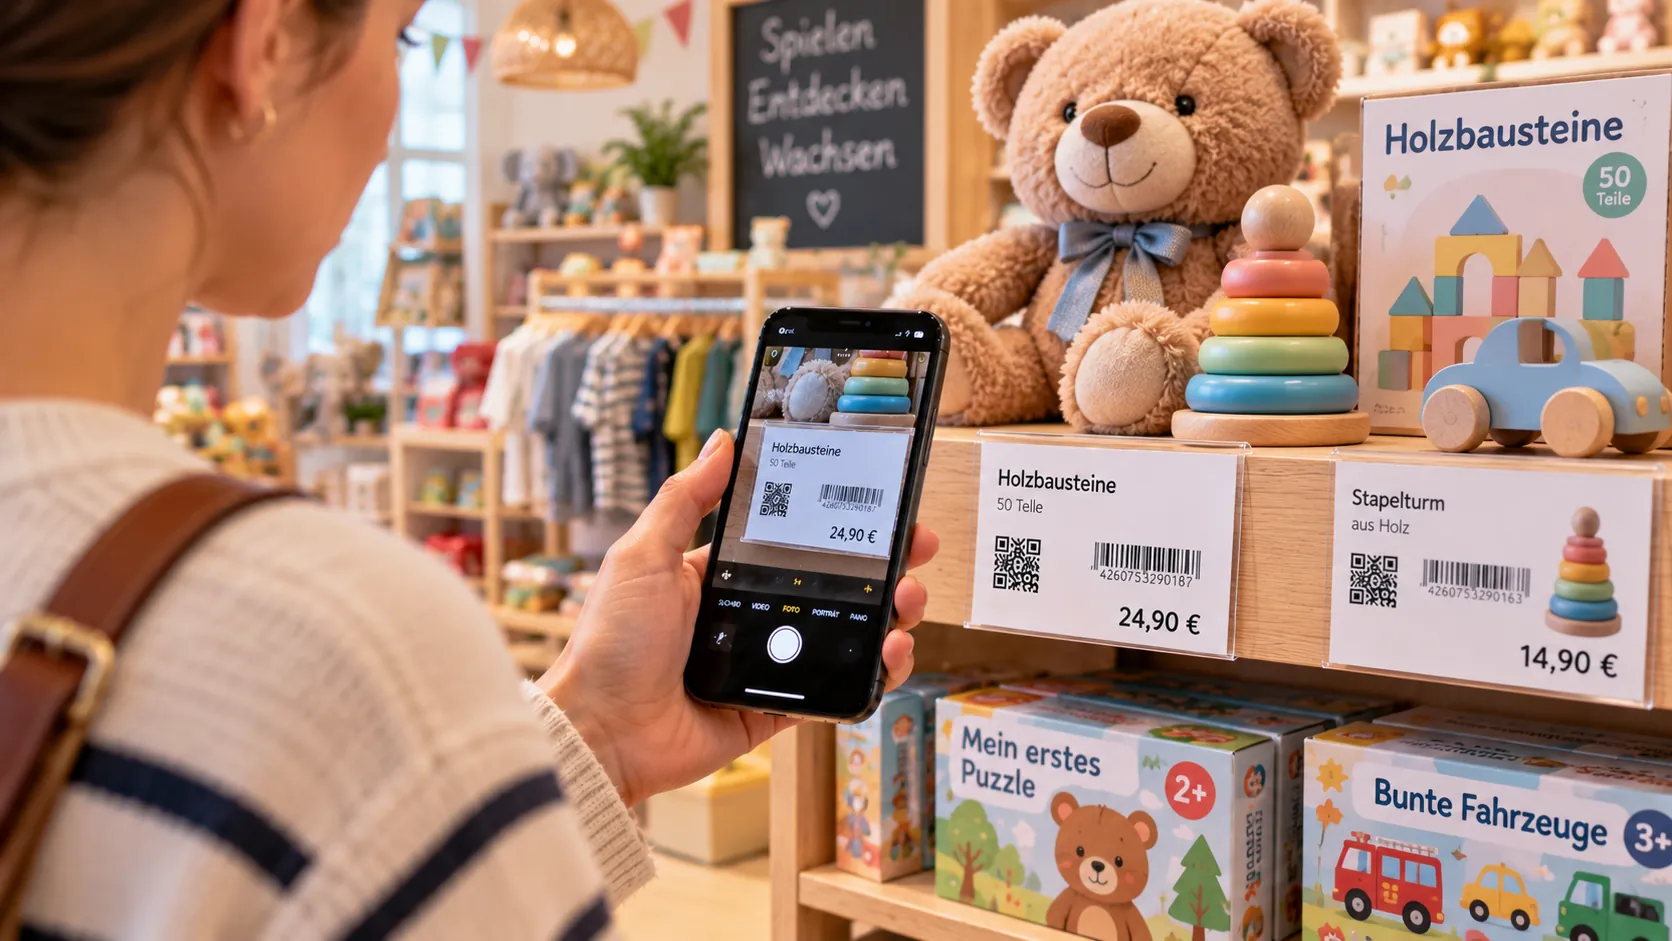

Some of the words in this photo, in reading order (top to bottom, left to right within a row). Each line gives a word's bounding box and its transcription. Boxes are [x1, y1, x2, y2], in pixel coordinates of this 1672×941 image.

[759, 8, 878, 74] Spielen
[748, 65, 909, 124] Entdecken
[1385, 110, 1623, 155] Holzbausteine
[758, 127, 898, 179] Wachsen
[1599, 165, 1631, 189] 50
[1596, 192, 1631, 206] Teile
[772, 442, 841, 456] Holzbausteine
[769, 458, 779, 467] 50
[998, 468, 1116, 493] Holzbausteine
[997, 497, 1012, 511] 50
[1352, 489, 1445, 512] Stapelturm
[830, 526, 864, 542] 24,90
[867, 529, 877, 543] €
[1351, 519, 1375, 532] aus
[1379, 519, 1410, 535] Holz
[1100, 569, 1193, 588] 4260753290187
[1428, 587, 1523, 604] 4260753290163
[782, 605, 800, 613] FOTO
[850, 613, 868, 621] PANO
[1119, 606, 1179, 632] 24,90
[1186, 614, 1201, 635] €
[1521, 645, 1590, 674] 14,90
[1600, 654, 1618, 678] €
[961, 726, 1018, 760] Mein
[1026, 741, 1101, 777] erstes
[961, 758, 1036, 799] Puzzle
[1173, 774, 1207, 805] 2+
[1375, 777, 1452, 818] Bunte
[1461, 793, 1608, 852] Fahrzeuge
[1634, 822, 1672, 853] 3+
